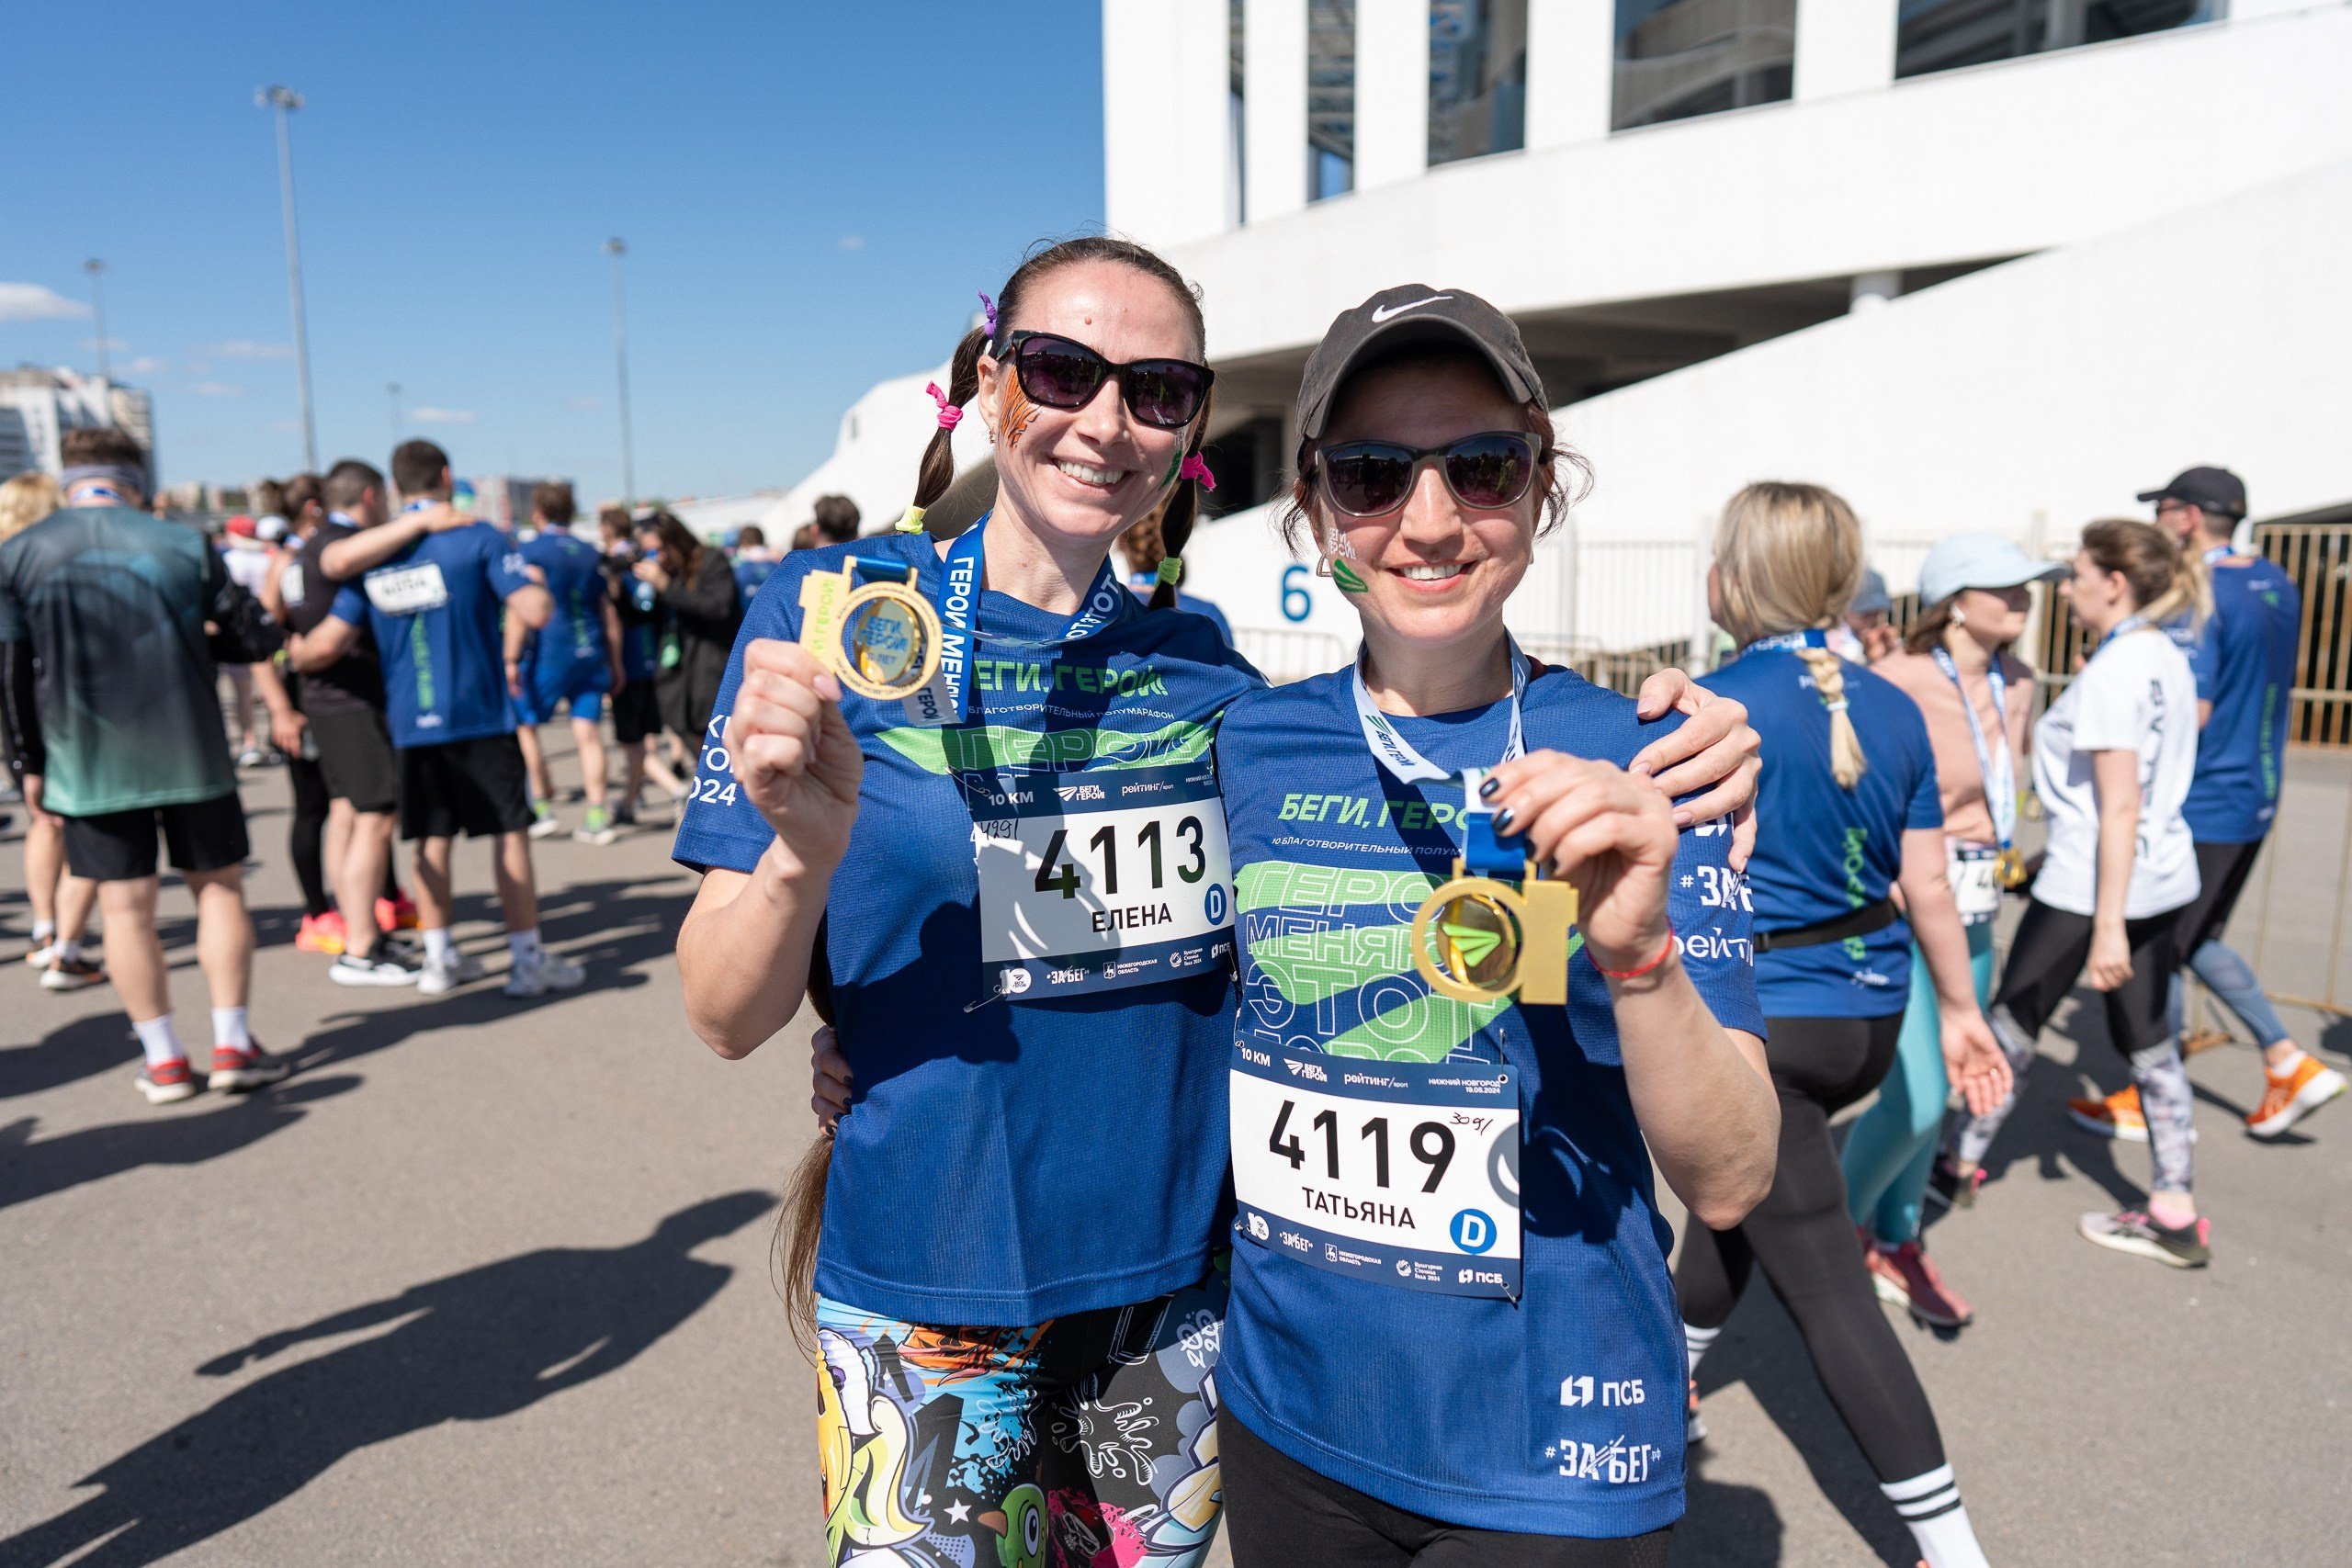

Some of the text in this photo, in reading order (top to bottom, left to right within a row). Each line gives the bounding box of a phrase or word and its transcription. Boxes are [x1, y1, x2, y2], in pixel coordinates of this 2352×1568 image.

[945, 556, 975, 628] ГЕРОИ
[1282, 565, 1311, 622] 6
[974, 660, 1169, 698] ЕГИ, ГЕРОЙ!
[989, 793, 1006, 807] 10
[1277, 793, 1468, 830] БЕГИ, ГЕРО
[1035, 816, 1206, 899] 4113
[1414, 846, 1462, 856] ПОЛУМ
[1209, 889, 1223, 919] D
[1248, 860, 1446, 925] ГЕРО
[1091, 902, 1173, 933] ЕЛЕНА
[1241, 1047, 1271, 1067] 10 КМ
[1269, 1100, 1456, 1193] 4119
[1301, 1186, 1416, 1230] ТАТЬЯНА
[1460, 1213, 1487, 1247] D
[1476, 1271, 1503, 1284] ПСБ
[1602, 1379, 1645, 1407] ПСБ
